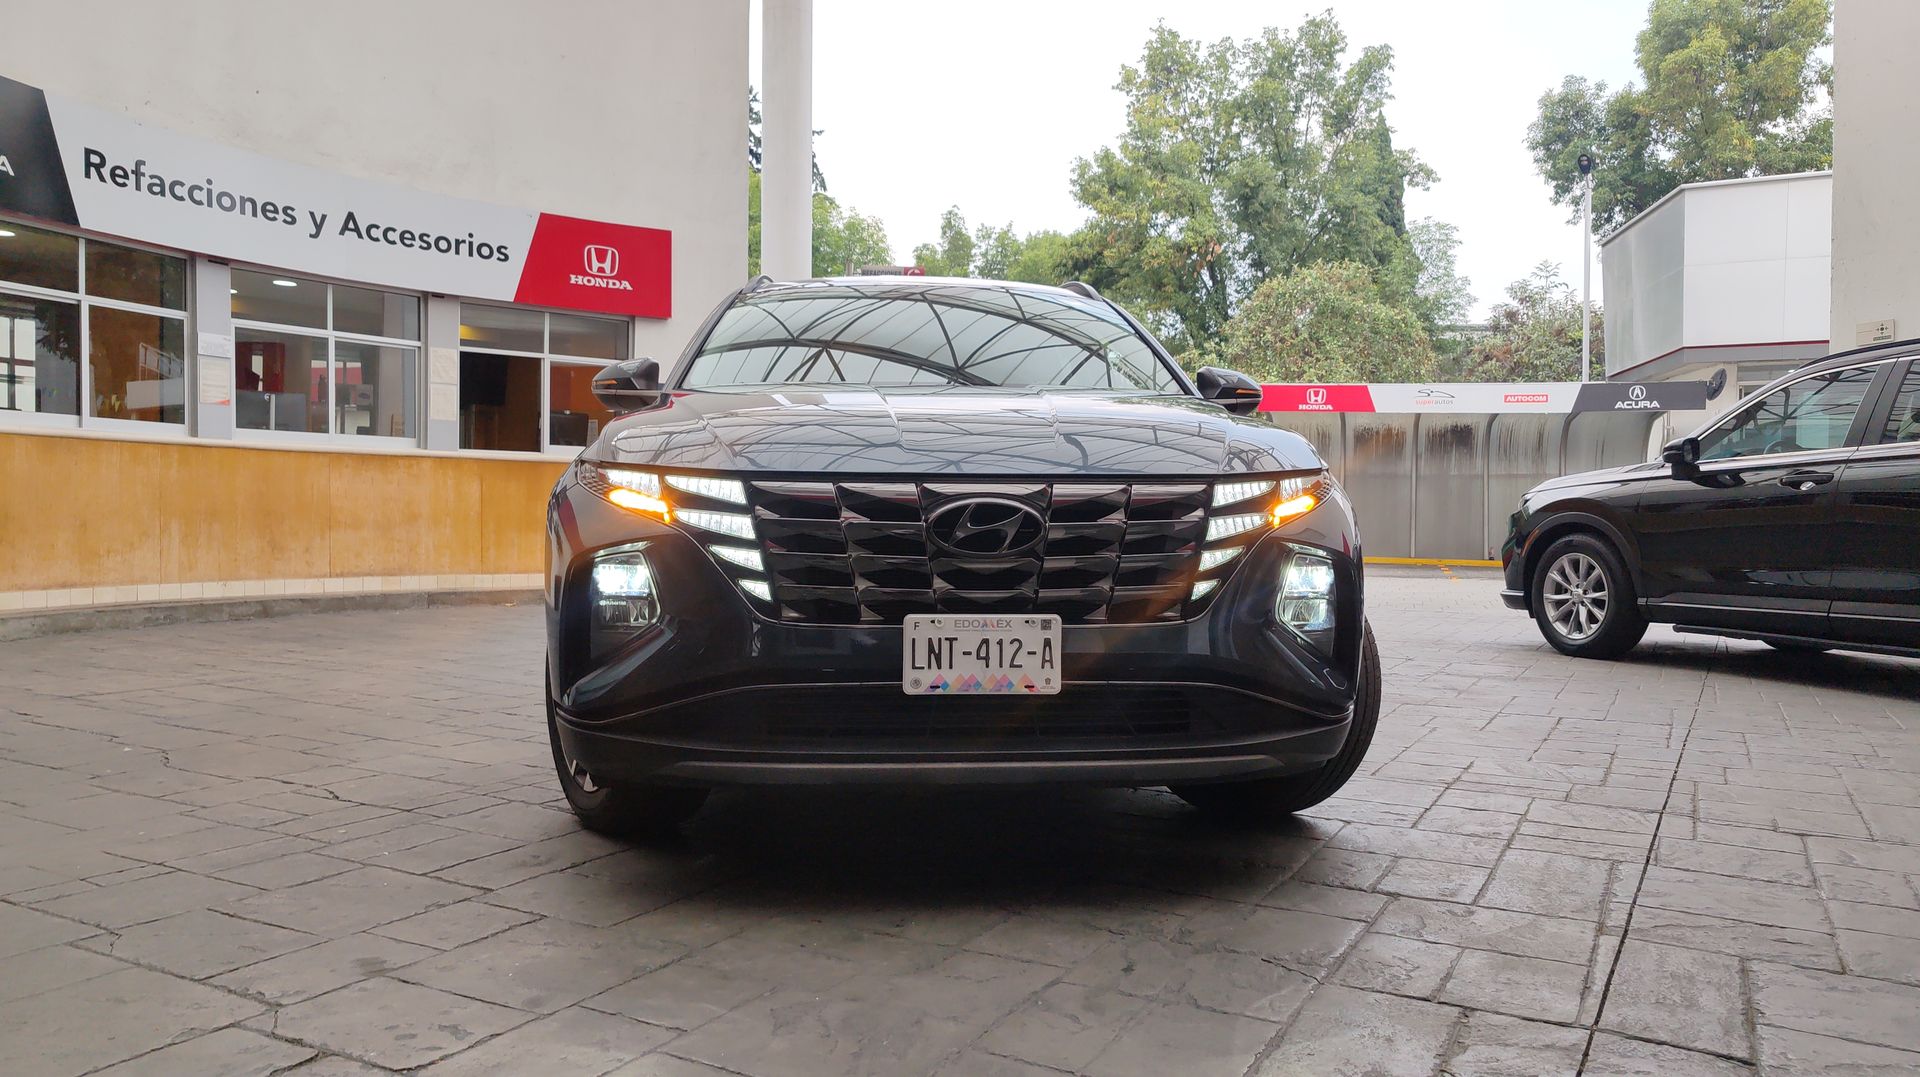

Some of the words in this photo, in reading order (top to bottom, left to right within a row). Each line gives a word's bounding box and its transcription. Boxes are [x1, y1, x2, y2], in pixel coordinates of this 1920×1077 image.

[83, 147, 297, 226] Refacciones
[308, 210, 328, 239] y
[339, 211, 510, 263] Accesorios
[569, 273, 633, 291] HONDA
[1415, 399, 1455, 407] superautos
[1614, 400, 1661, 410] ACURA
[913, 621, 921, 631] F
[911, 637, 1055, 670] LNT-412-A
